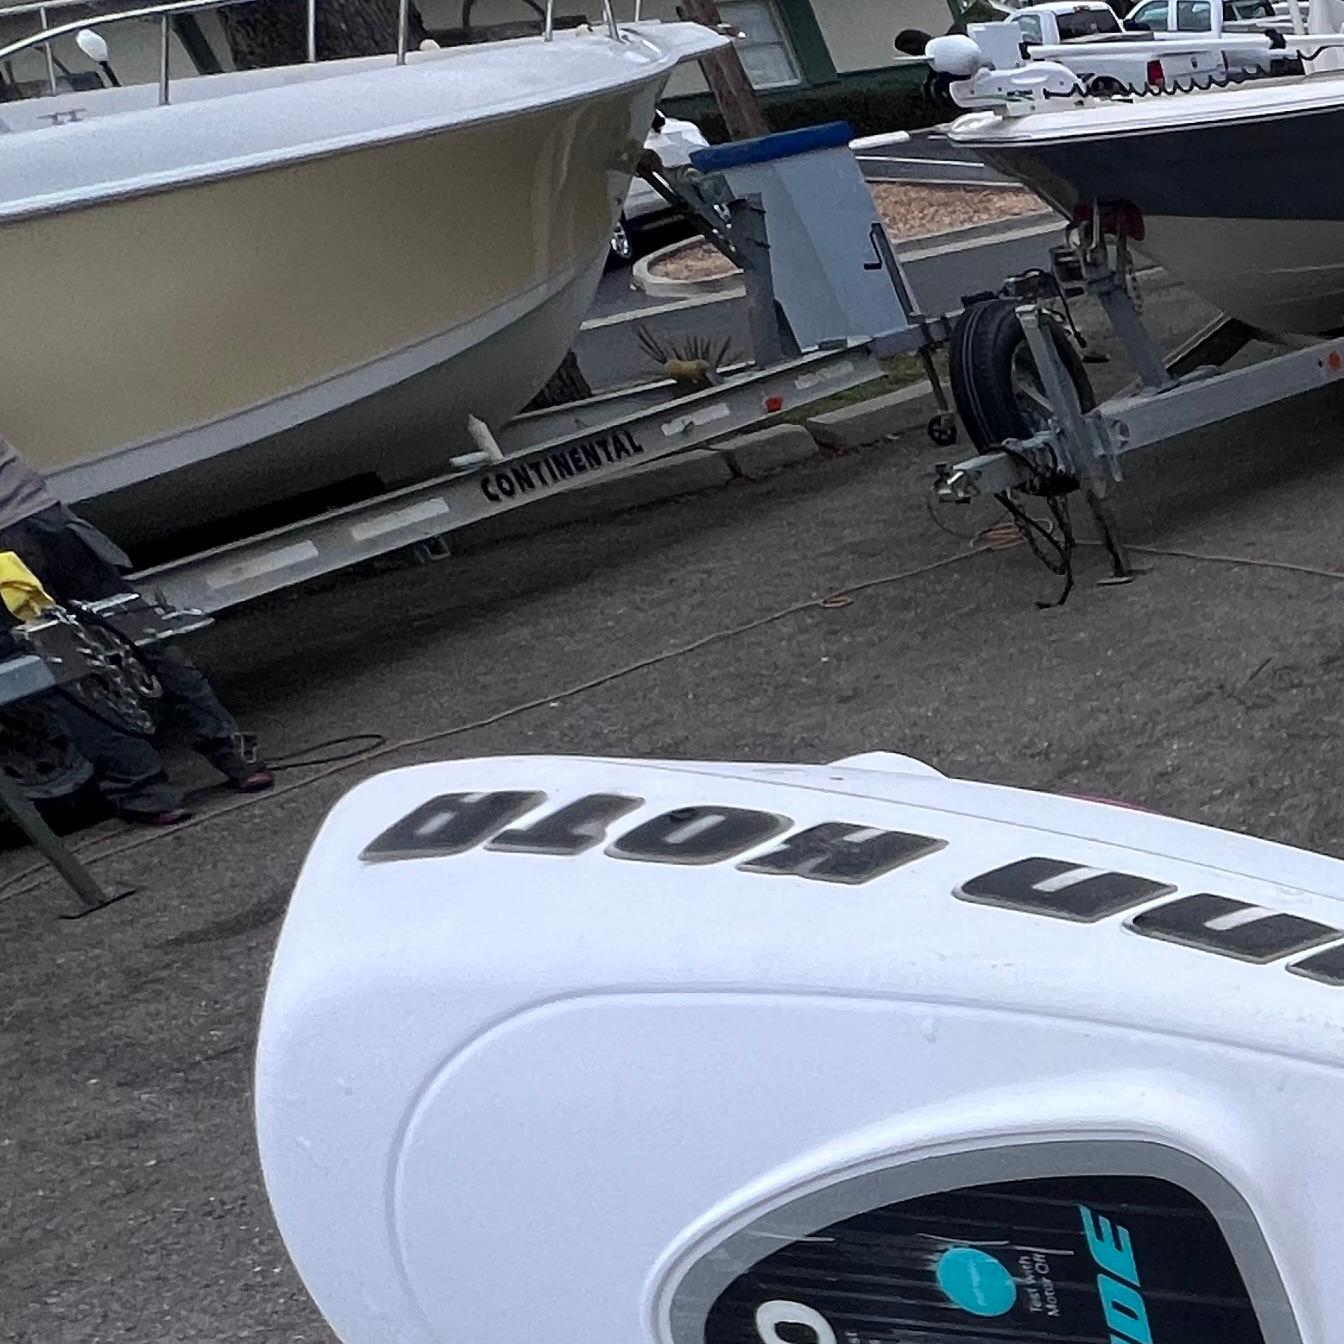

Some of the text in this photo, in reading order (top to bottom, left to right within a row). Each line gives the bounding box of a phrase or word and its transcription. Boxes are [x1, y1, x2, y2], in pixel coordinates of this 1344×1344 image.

[480, 429, 645, 503] CONTINENTAL
[357, 789, 950, 886] KOTA
[1026, 1287, 1042, 1313] Test
[1032, 1252, 1060, 1317] Motor Off
